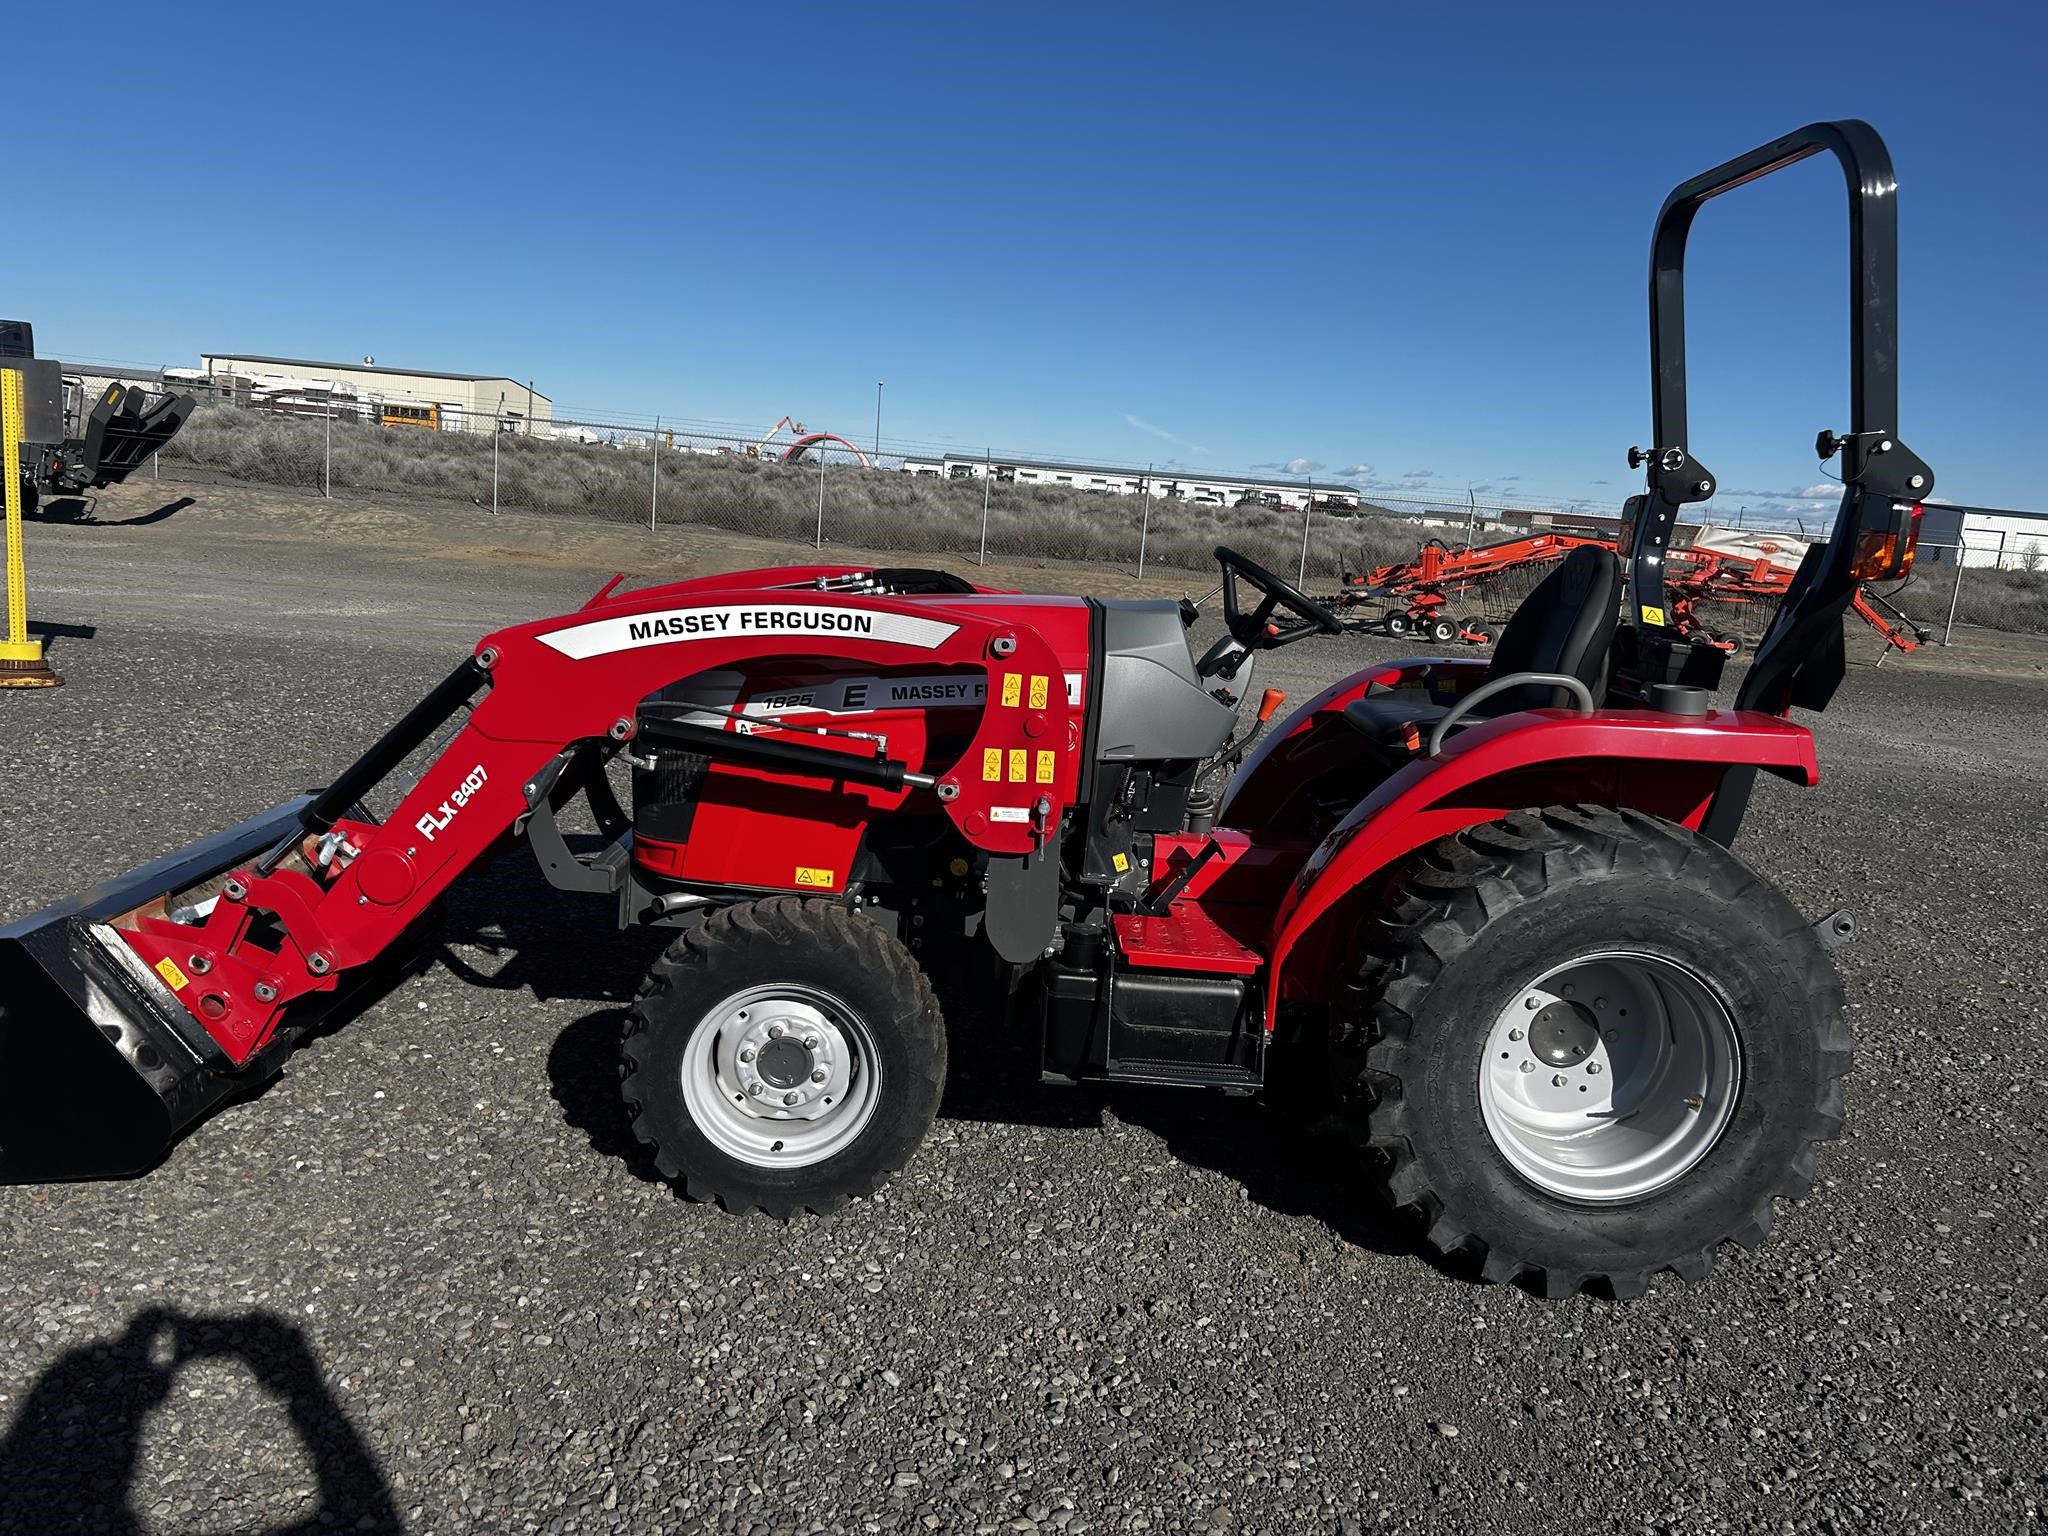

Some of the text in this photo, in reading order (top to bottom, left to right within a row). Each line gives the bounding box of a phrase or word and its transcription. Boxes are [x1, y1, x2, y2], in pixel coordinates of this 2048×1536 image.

[628, 611, 873, 641] MASSEY FERGUSON
[763, 692, 815, 710] 1825
[841, 684, 869, 708] E
[891, 683, 967, 701] MASSEY
[415, 764, 488, 842] FLX 2407
